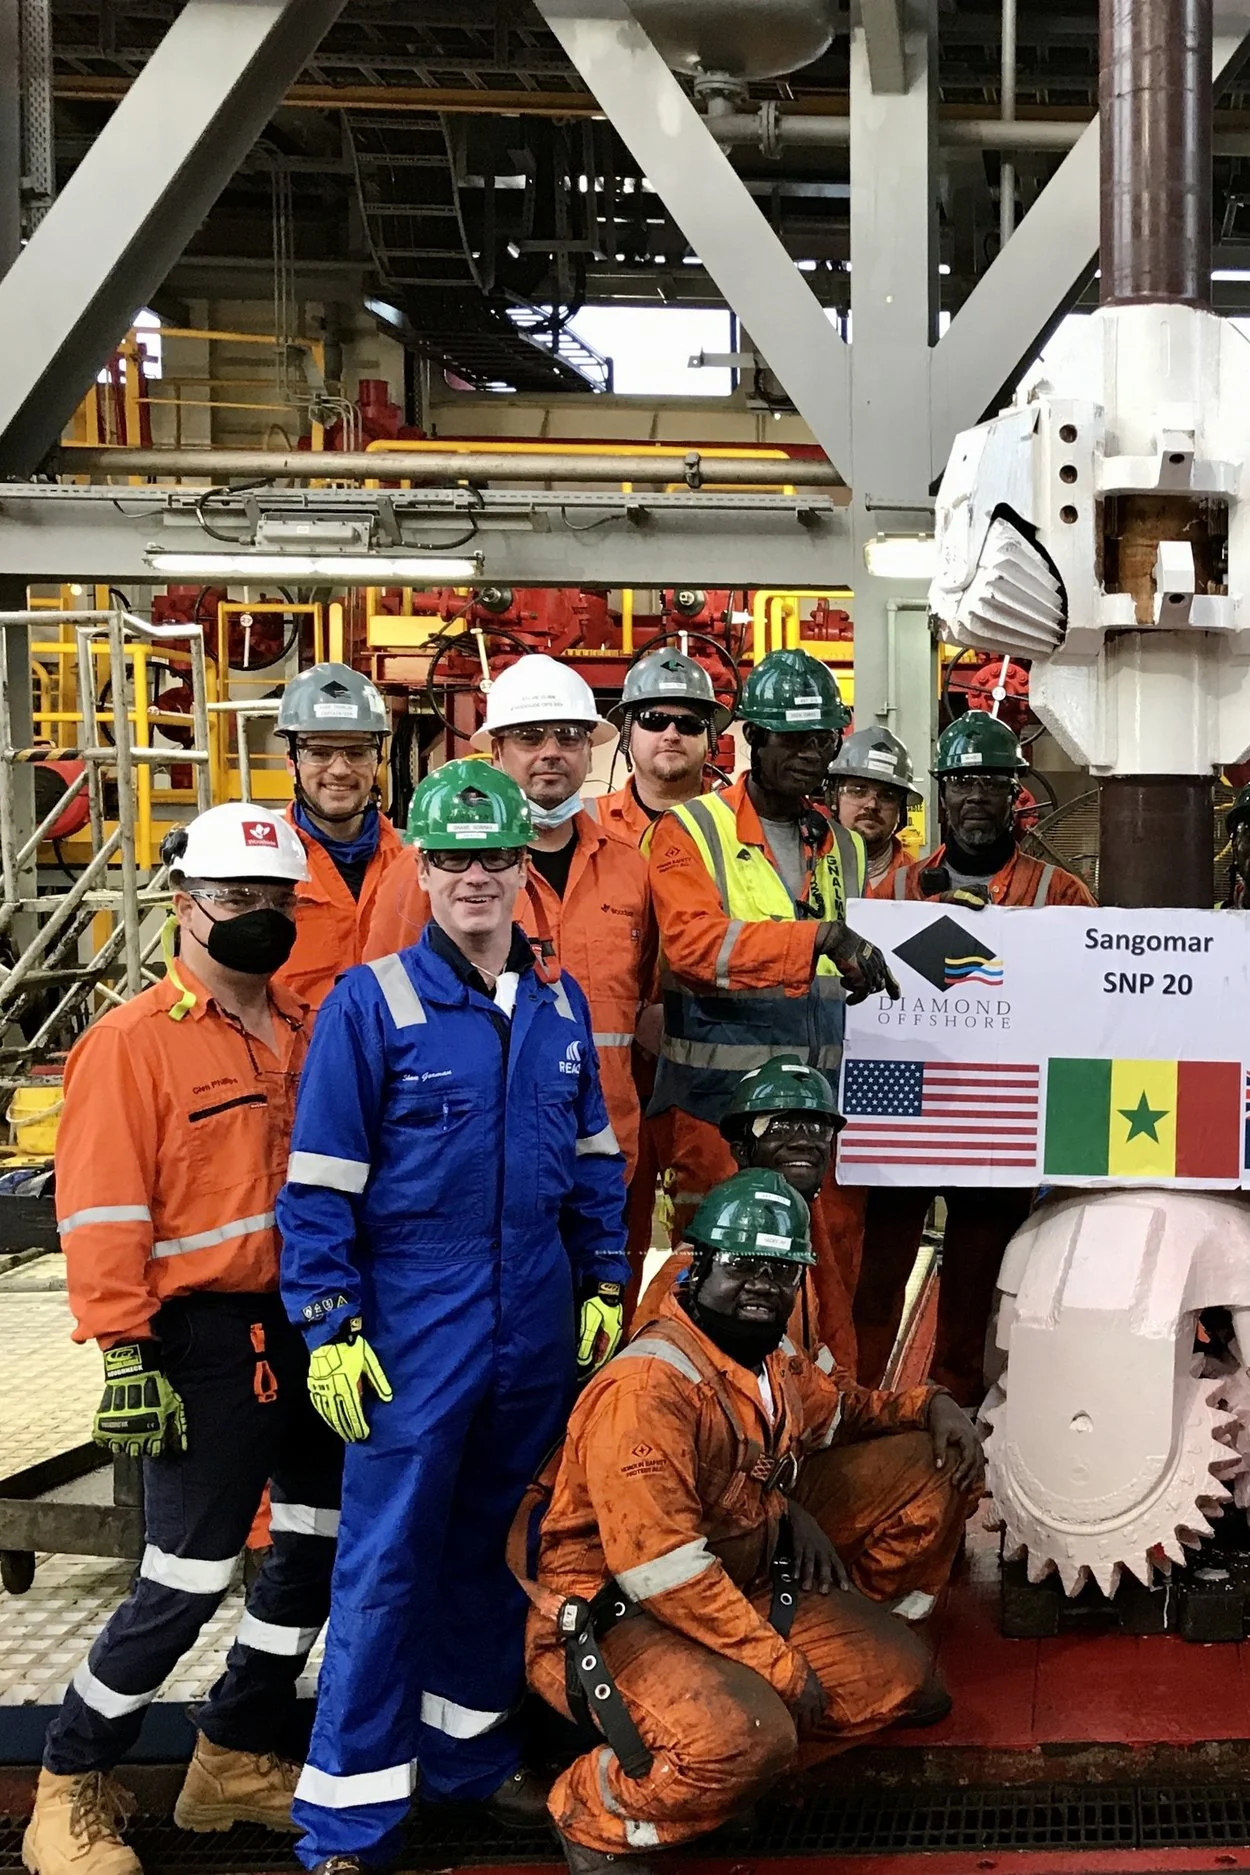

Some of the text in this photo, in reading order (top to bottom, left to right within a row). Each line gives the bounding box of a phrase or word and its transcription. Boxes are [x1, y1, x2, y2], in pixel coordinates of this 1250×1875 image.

[1085, 928, 1214, 956] Sangomar
[1103, 972, 1193, 995] SNP 20
[879, 996, 1011, 1015] DIAMOND
[878, 1013, 1011, 1029] OFFSHORE
